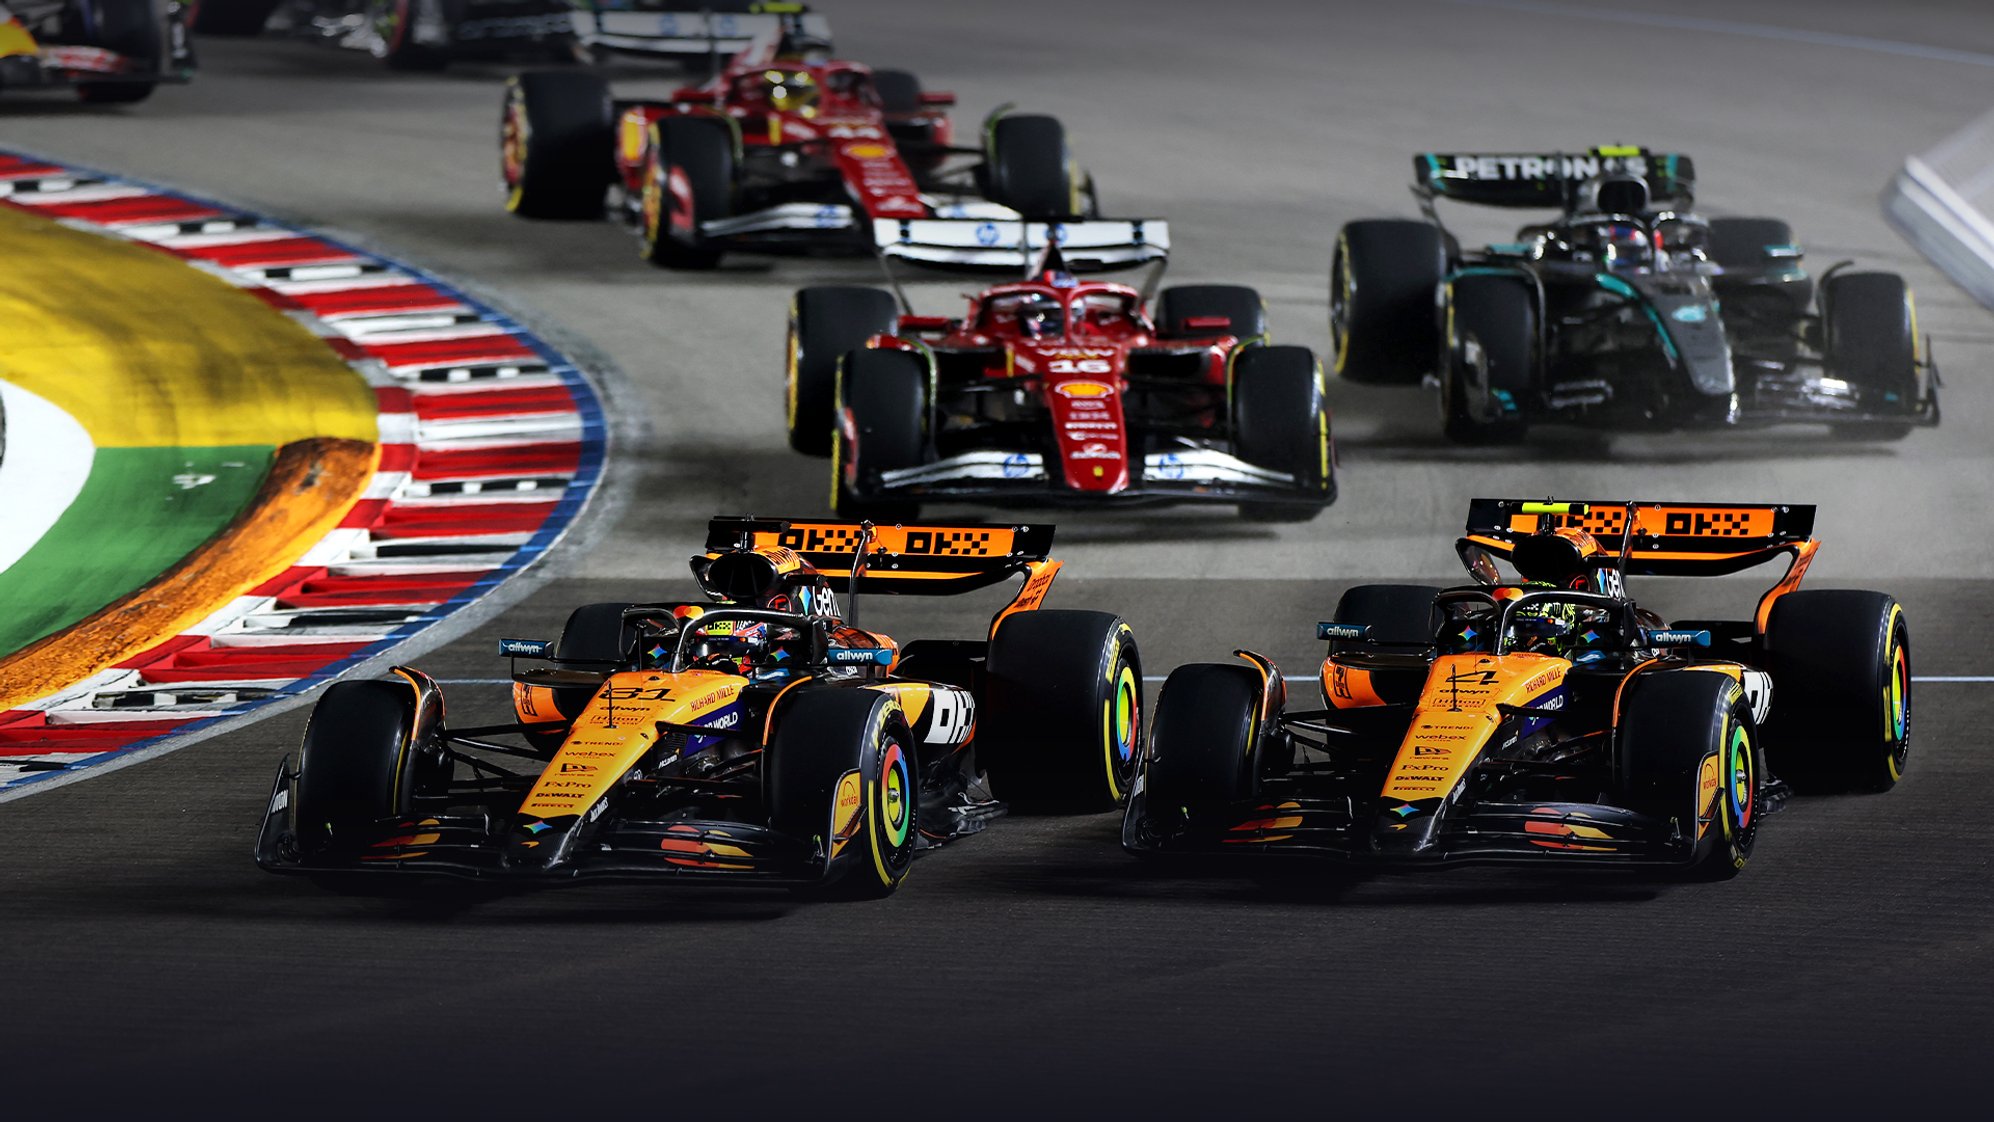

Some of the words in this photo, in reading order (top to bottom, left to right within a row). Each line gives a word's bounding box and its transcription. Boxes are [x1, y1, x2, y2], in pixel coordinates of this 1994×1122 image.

[1048, 359, 1112, 374] 16
[1665, 512, 1750, 536] OKX
[905, 531, 989, 555] OKX
[1326, 626, 1359, 639] allwyn
[1655, 632, 1691, 644] allwyn
[507, 641, 540, 655] allwyn
[836, 648, 874, 662] allwyn
[1445, 670, 1499, 685] 4
[598, 687, 676, 702] 81
[690, 692, 716, 712] RICHARD
[543, 781, 592, 789] FxPro
